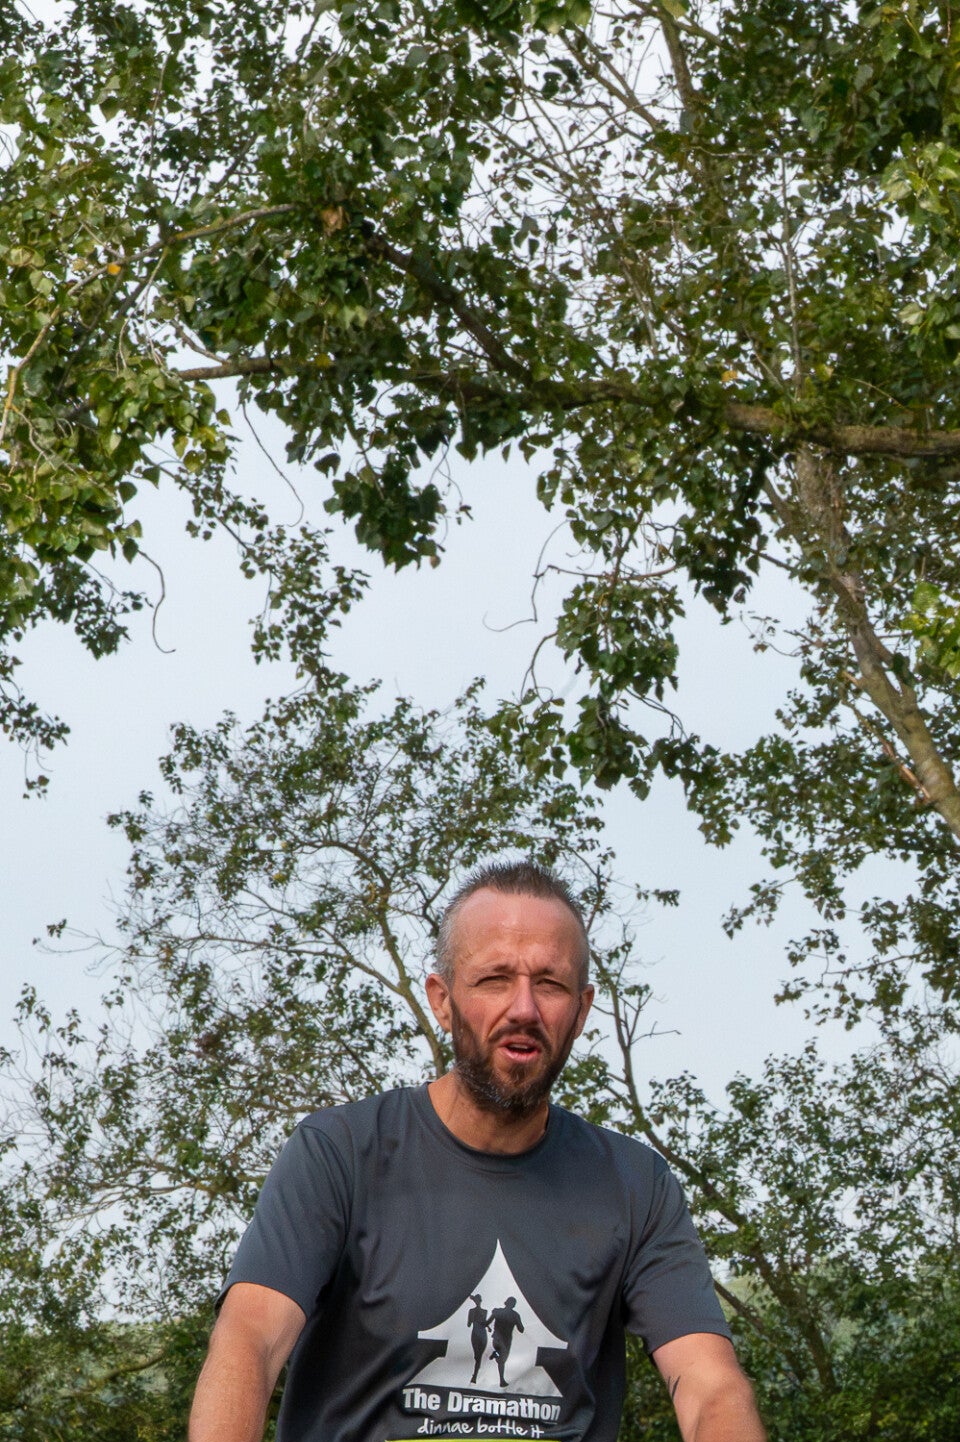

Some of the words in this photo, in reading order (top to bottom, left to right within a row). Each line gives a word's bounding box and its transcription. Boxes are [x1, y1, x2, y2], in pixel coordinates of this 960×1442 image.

[402, 1388, 441, 1411] The
[447, 1391, 562, 1422] Dramathon
[417, 1418, 474, 1434] dinnae
[477, 1417, 528, 1436] bottle
[530, 1424, 544, 1439] it
